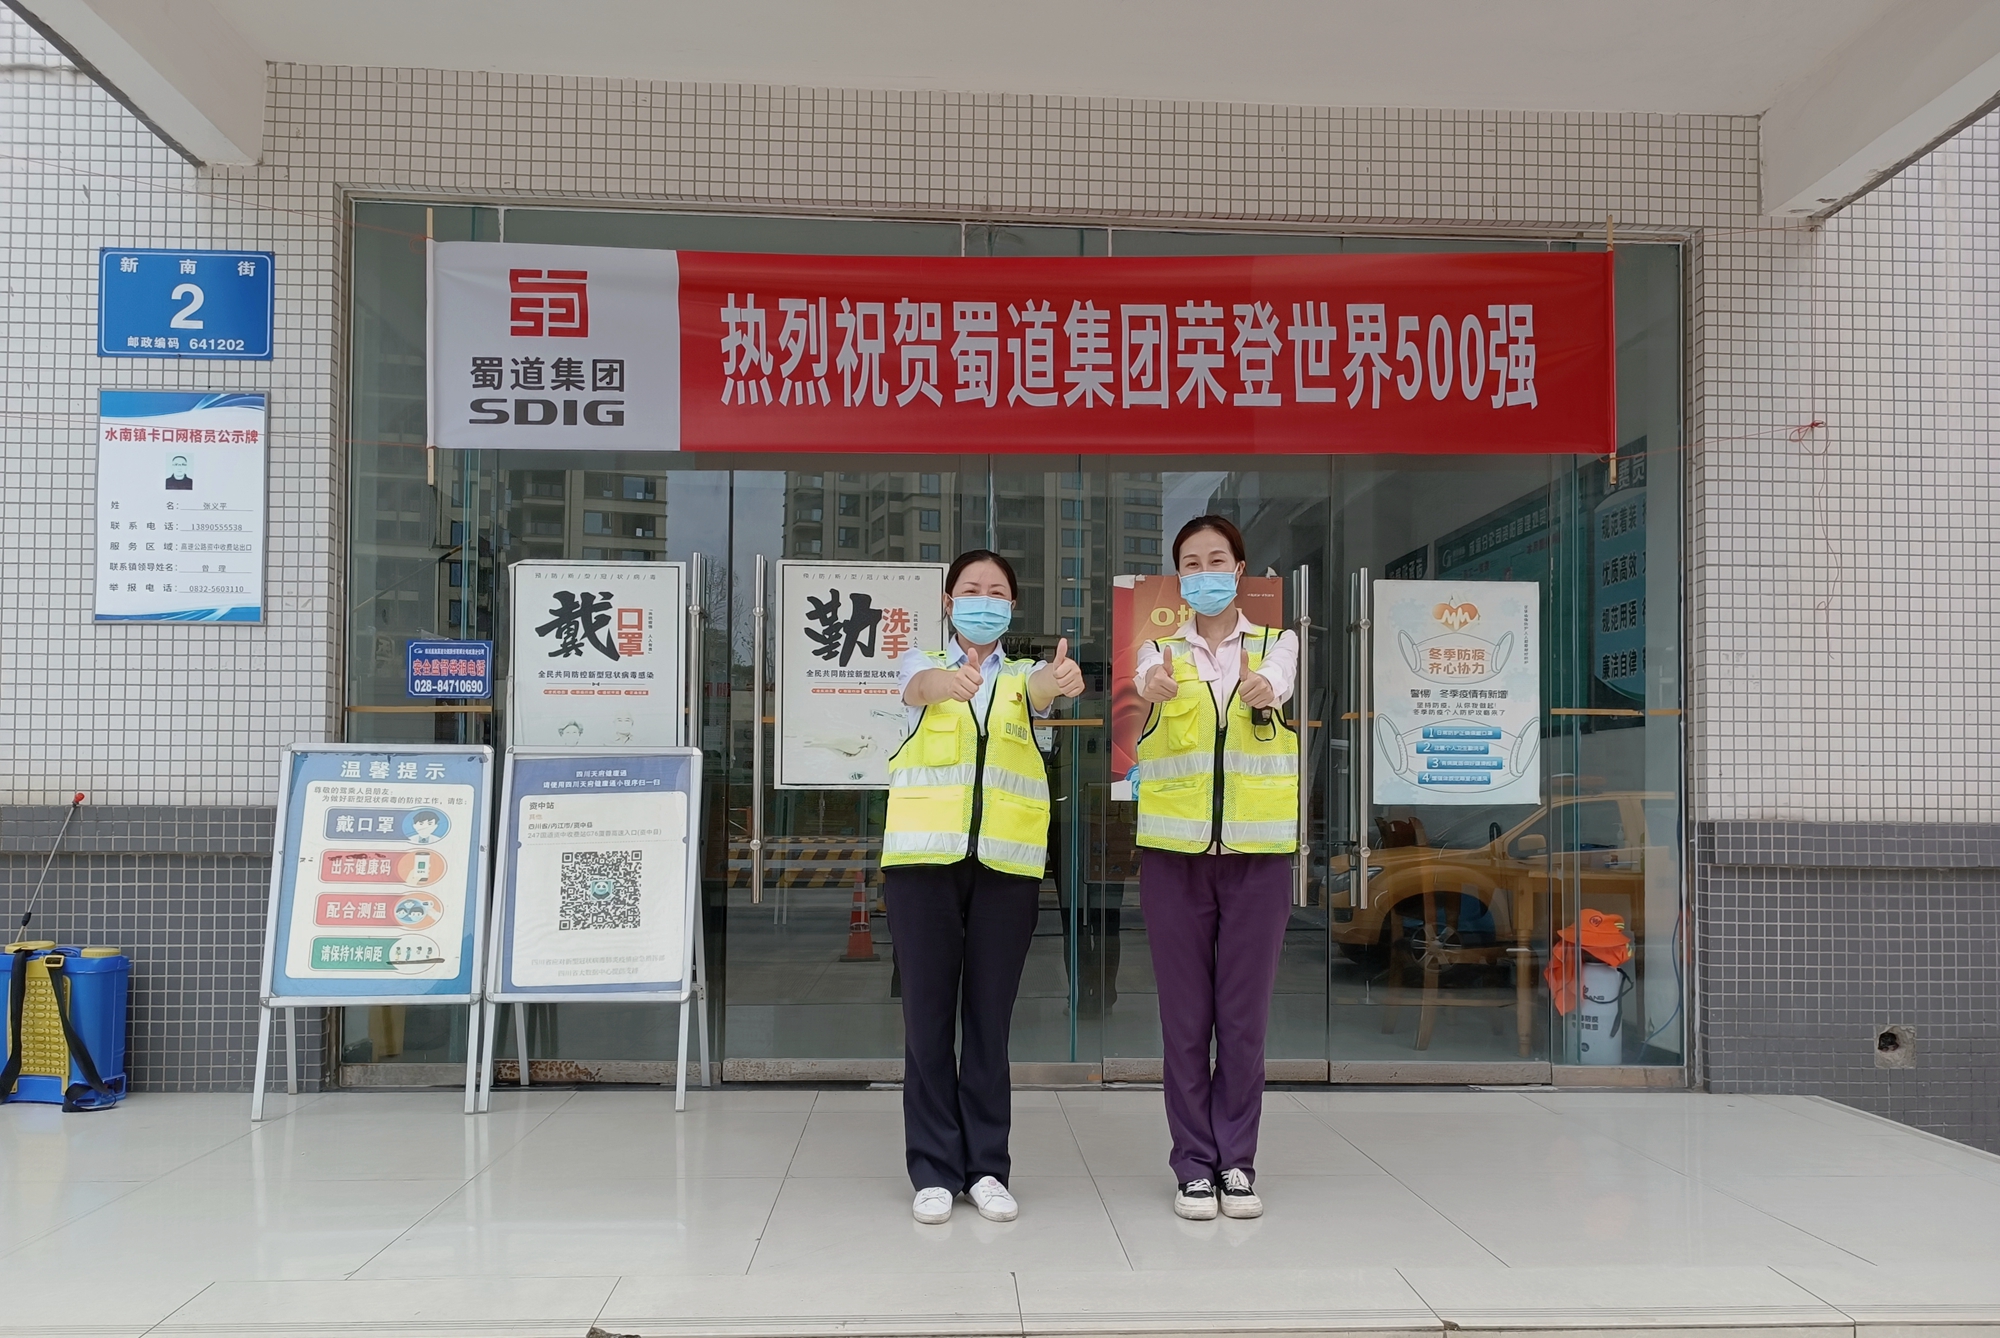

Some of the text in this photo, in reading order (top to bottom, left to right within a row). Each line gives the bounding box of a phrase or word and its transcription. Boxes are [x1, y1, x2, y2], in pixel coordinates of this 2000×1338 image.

[120, 257, 256, 277] 新南街
[170, 283, 205, 330] 2
[127, 336, 245, 351] 邮政编码 641202
[720, 293, 1539, 410] 热烈祝贺蜀道集团荣登世界500强
[470, 356, 625, 393] 蜀道集团
[469, 398, 625, 426] SDIG
[105, 427, 259, 444] 水南镇卡口网格员公示牌
[191, 523, 243, 531] 13890555538
[189, 585, 244, 593] 0832-5603110
[535, 591, 645, 662] 戴 口罩
[804, 588, 911, 668] 勤 洗手
[1428, 647, 1485, 661] 冬季防疫
[412, 658, 485, 677] 安全监督举报电话
[538, 670, 655, 680] 全民共同防控新型冠状病毒感染
[1428, 662, 1485, 675] 齐心协力
[414, 679, 483, 693] 028-84710690
[1440, 689, 1509, 699] 冬季疫情有新增
[1429, 727, 1435, 737] 1
[1423, 742, 1431, 752] 2
[340, 760, 446, 780] 温馨提示
[1432, 757, 1439, 768] 3
[1422, 772, 1430, 782] 4
[529, 802, 555, 811] 资中站
[336, 815, 394, 834] 戴口罩
[331, 858, 391, 876] 出示健康码
[326, 902, 387, 920] 配合测温
[321, 945, 383, 963] 请保持1米间距
